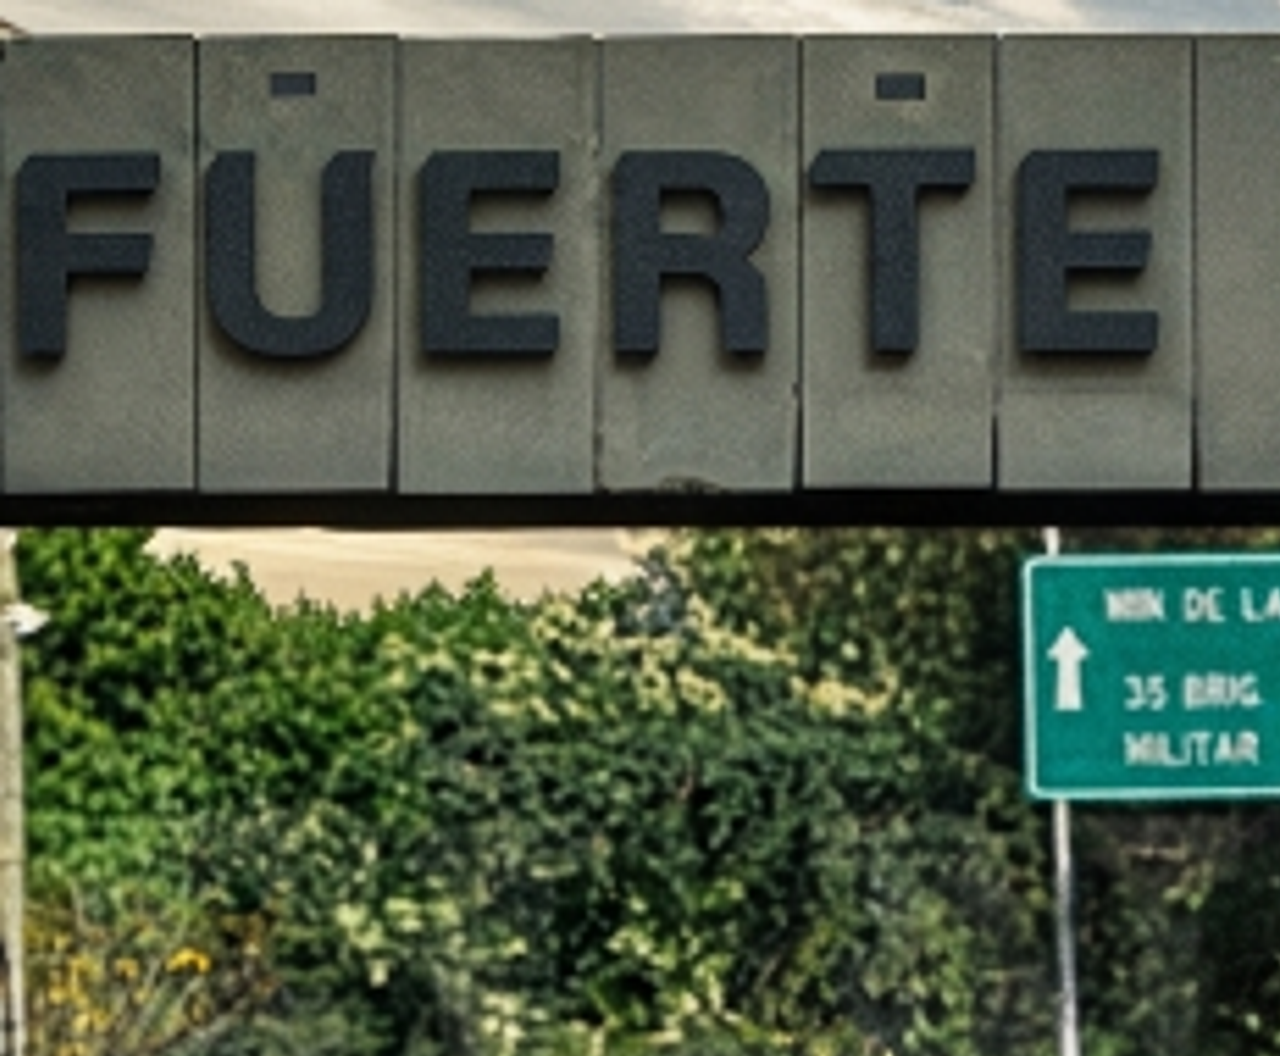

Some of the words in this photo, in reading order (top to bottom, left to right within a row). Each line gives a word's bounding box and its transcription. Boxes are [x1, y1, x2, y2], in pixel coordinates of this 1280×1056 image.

[12, 149, 1161, 360] FUERTE
[1183, 586, 1227, 623] DE
[1123, 673, 1169, 711] 35
[1123, 731, 1260, 768] MILITAR
